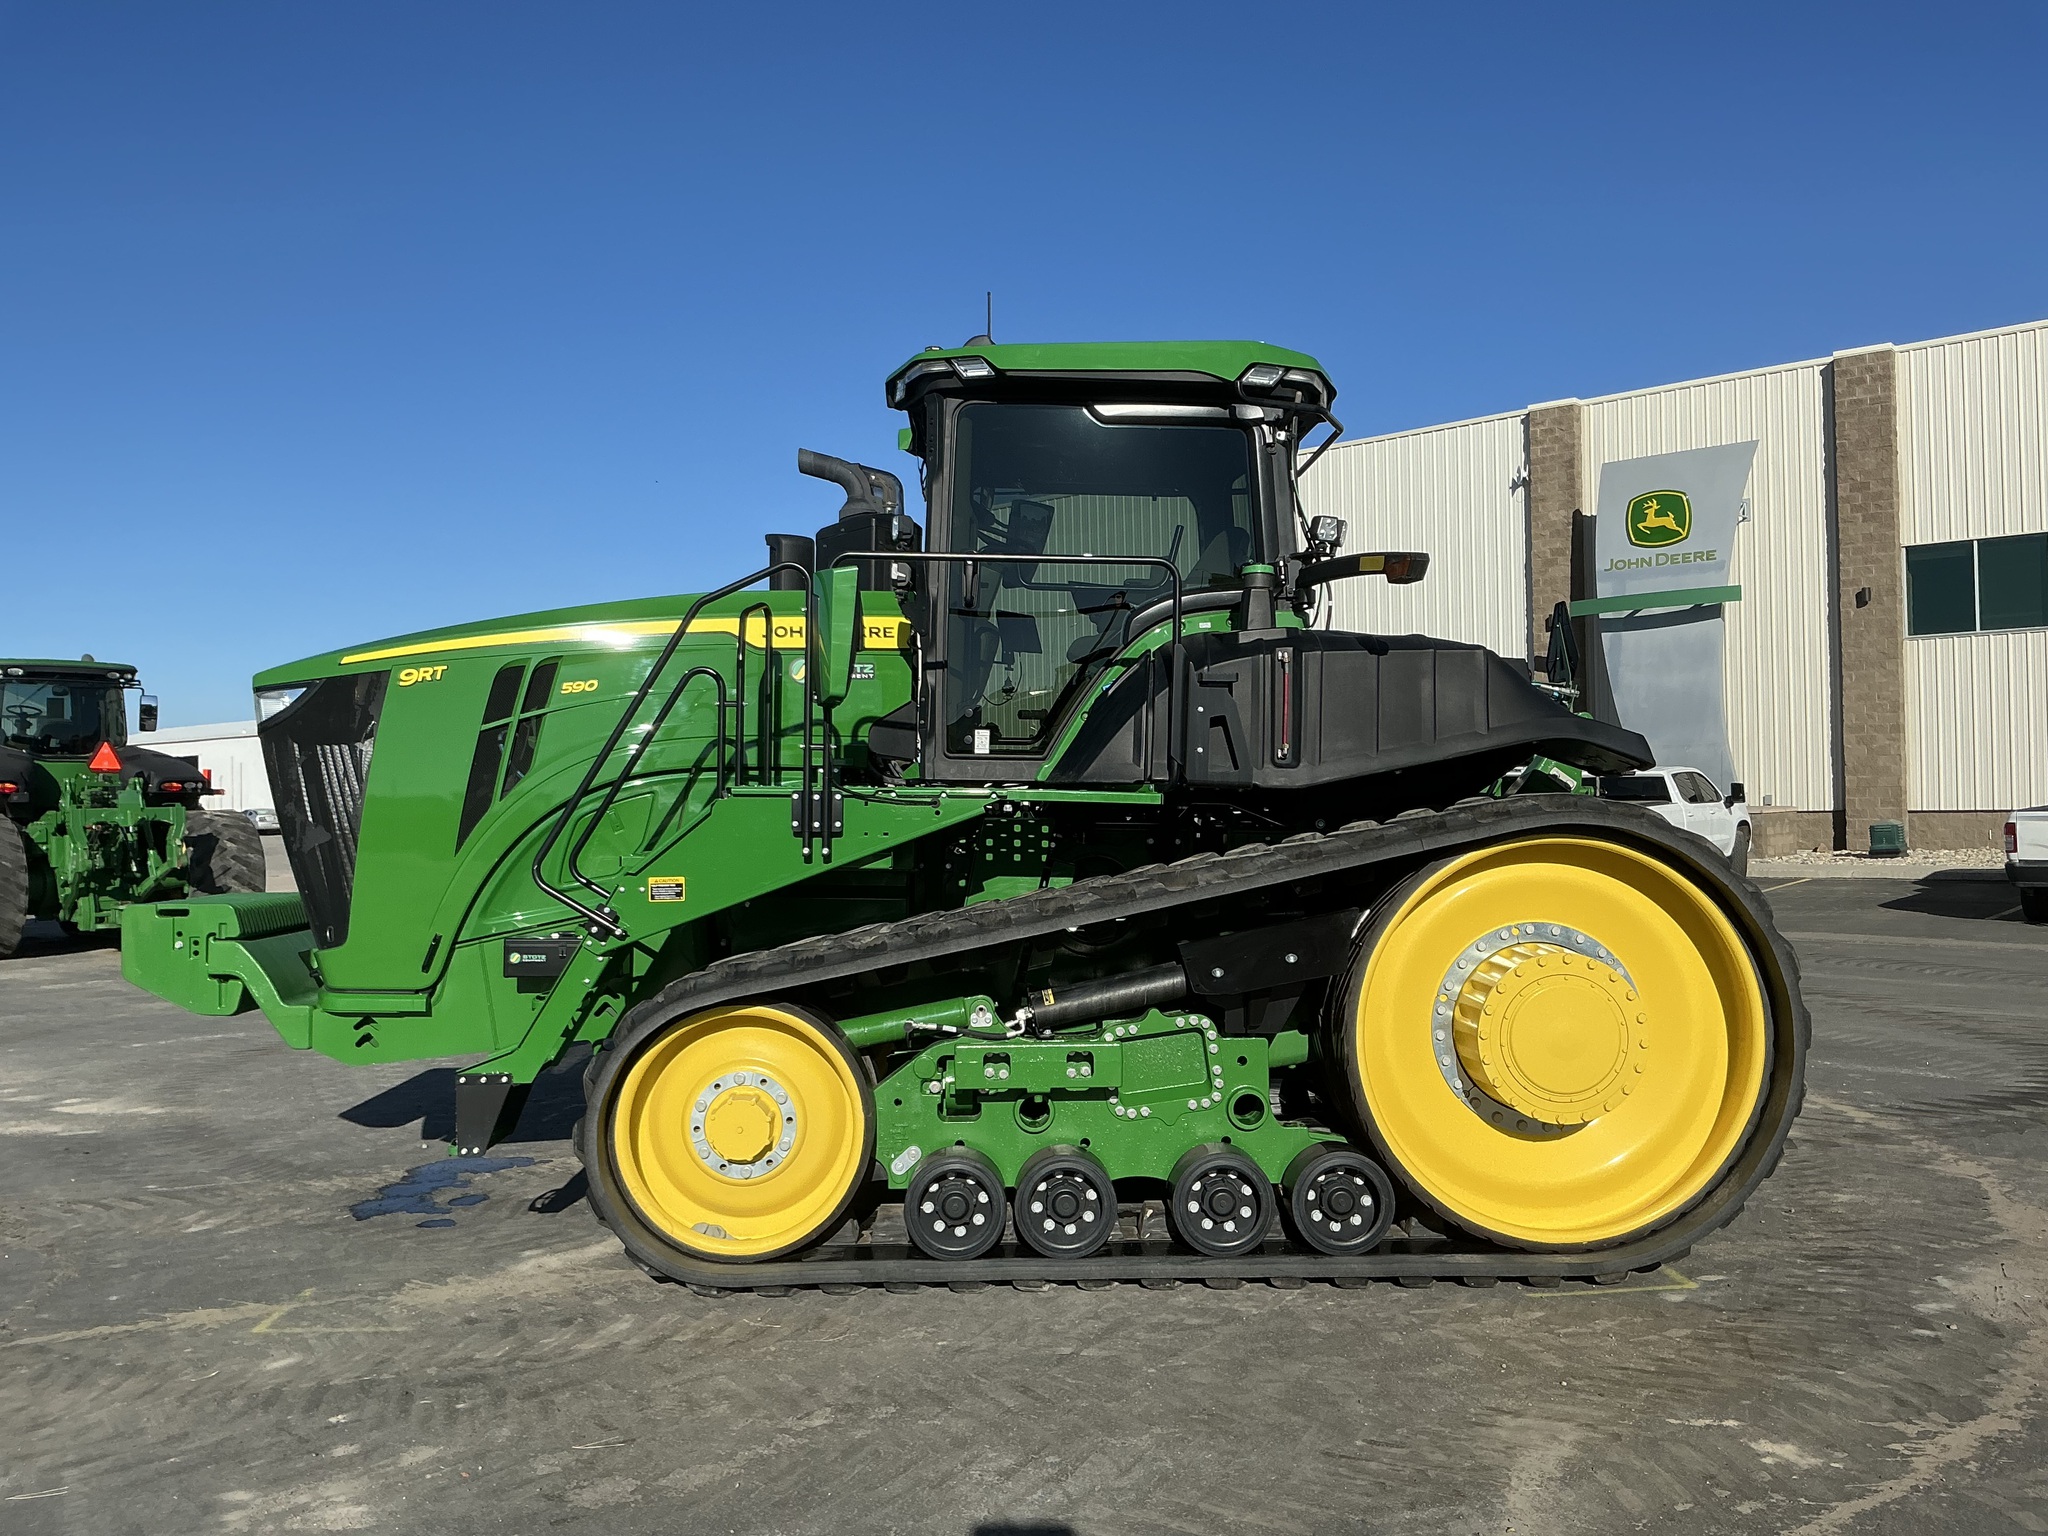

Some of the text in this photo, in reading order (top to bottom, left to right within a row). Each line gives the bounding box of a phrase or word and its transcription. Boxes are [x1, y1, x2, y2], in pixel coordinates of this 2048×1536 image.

[1604, 549, 1717, 572] JOHN DEERE
[399, 665, 448, 687] 9RT
[560, 679, 599, 694] 590
